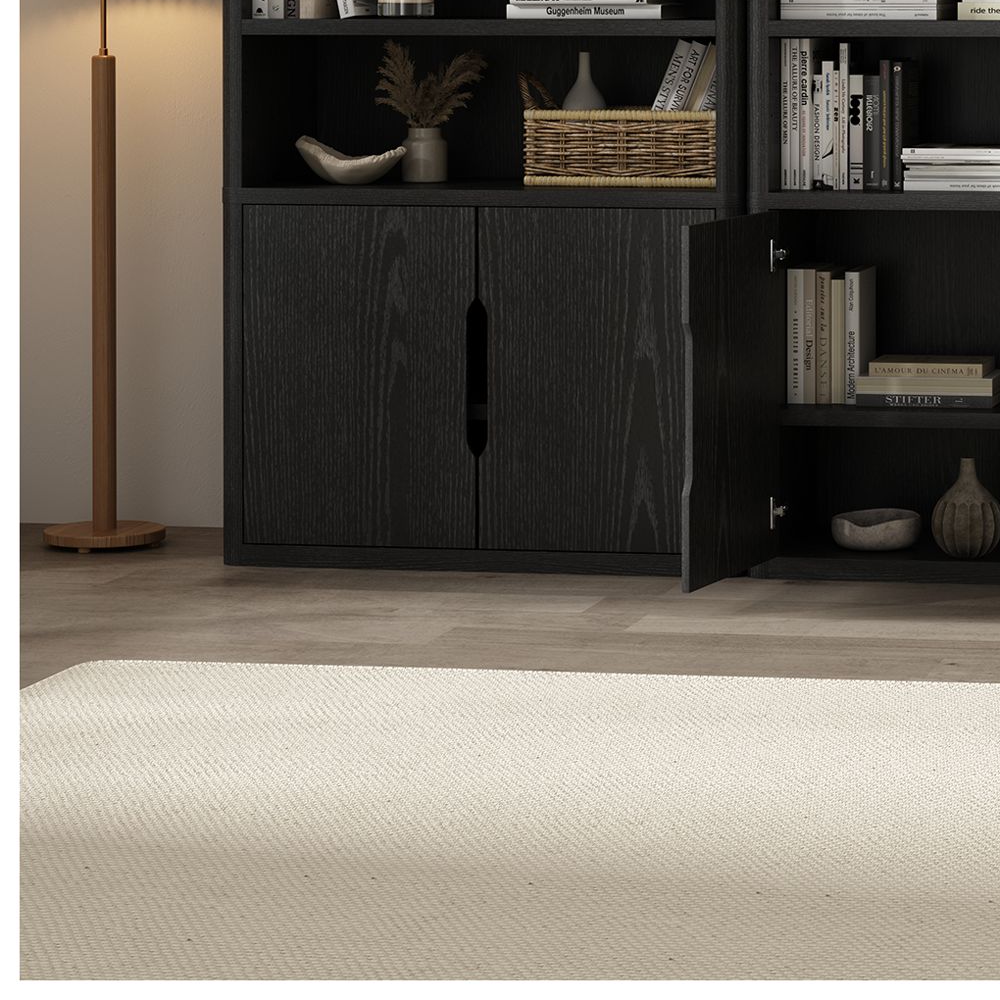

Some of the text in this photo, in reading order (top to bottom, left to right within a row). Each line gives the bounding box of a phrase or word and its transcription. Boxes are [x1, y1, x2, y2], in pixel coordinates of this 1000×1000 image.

[546, 7, 625, 17] Guggenheim Museum
[665, 53, 683, 86] MEN'S
[681, 49, 700, 84] ART FOR
[800, 51, 808, 77] pierre
[792, 92, 798, 102] OF
[804, 299, 814, 371] Editorial Design
[847, 331, 855, 400] Modern Architecture
[885, 395, 942, 404] STIFTER
